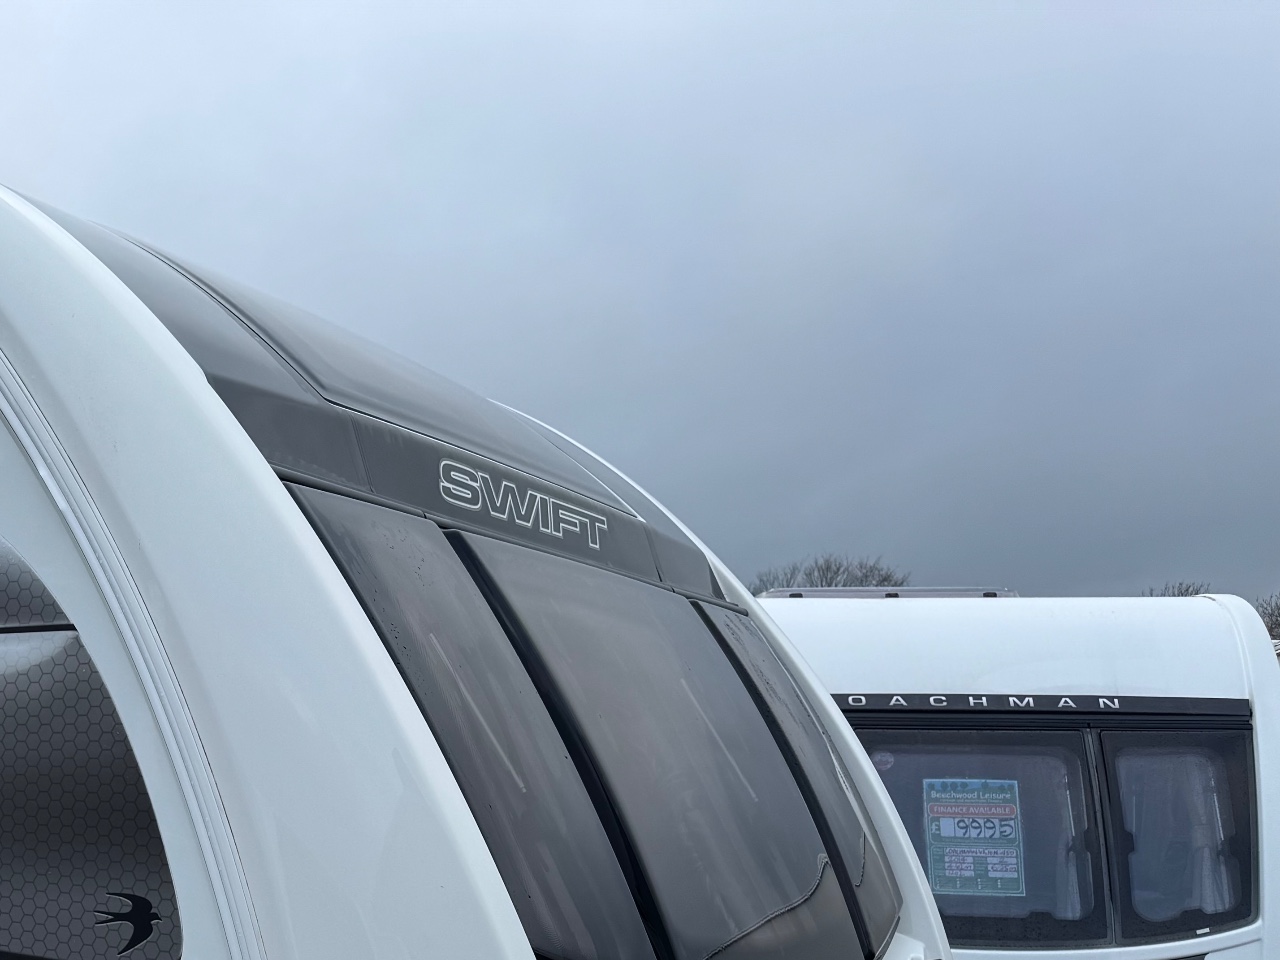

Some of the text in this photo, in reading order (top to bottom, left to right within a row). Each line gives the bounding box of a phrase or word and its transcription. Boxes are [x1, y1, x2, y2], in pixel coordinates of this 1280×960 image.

[440, 458, 608, 551] SWIFT
[847, 695, 1121, 709] OACHMAN
[930, 790, 1011, 800] Beechwood Leisure
[933, 806, 1011, 815] FINANCE AVAILABLE
[931, 821, 940, 835] £
